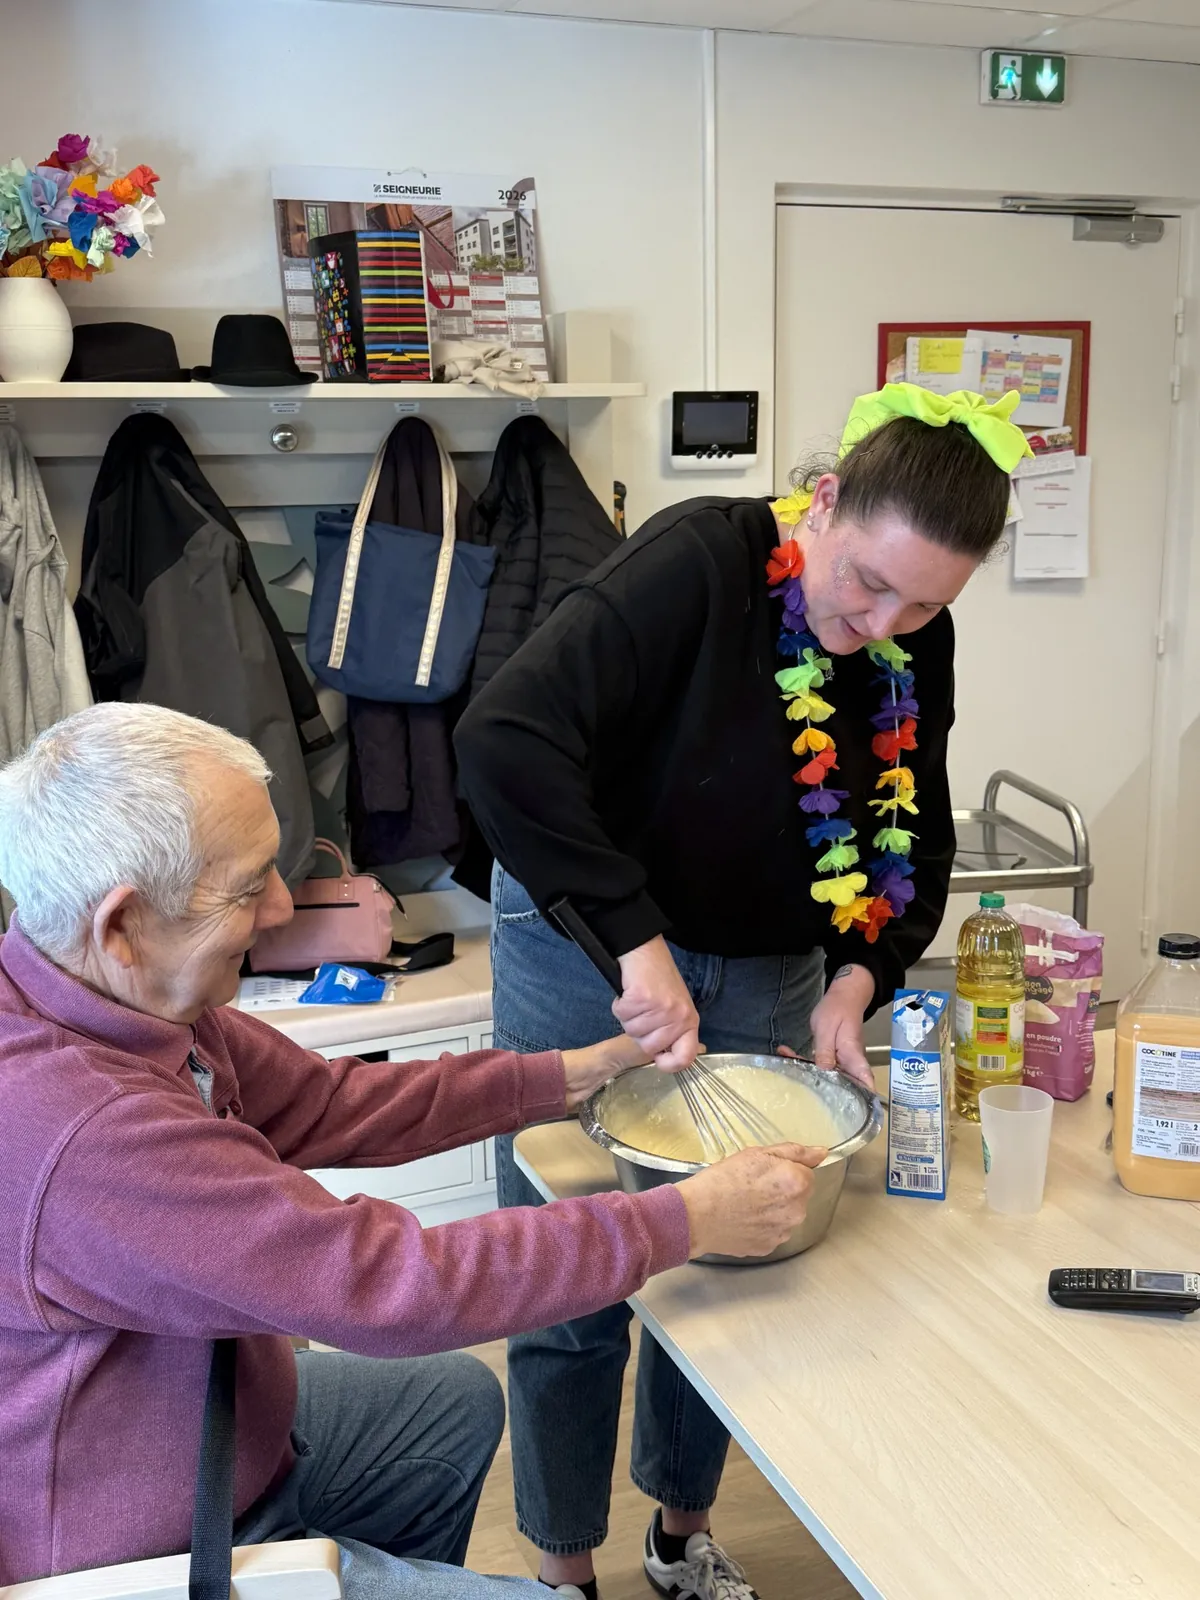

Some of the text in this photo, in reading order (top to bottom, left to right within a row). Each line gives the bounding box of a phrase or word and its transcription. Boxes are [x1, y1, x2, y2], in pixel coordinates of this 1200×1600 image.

[382, 184, 442, 195] SEIGNEURIE
[498, 190, 526, 200] 2026
[1024, 986, 1053, 995] ngagé
[1036, 1034, 1062, 1043] poudre
[1141, 1048, 1177, 1058] COCOTINE
[900, 1058, 930, 1072] lactel
[1027, 1069, 1036, 1078] kg
[1156, 1120, 1169, 1128] 1,92
[923, 1166, 928, 1174] 1
